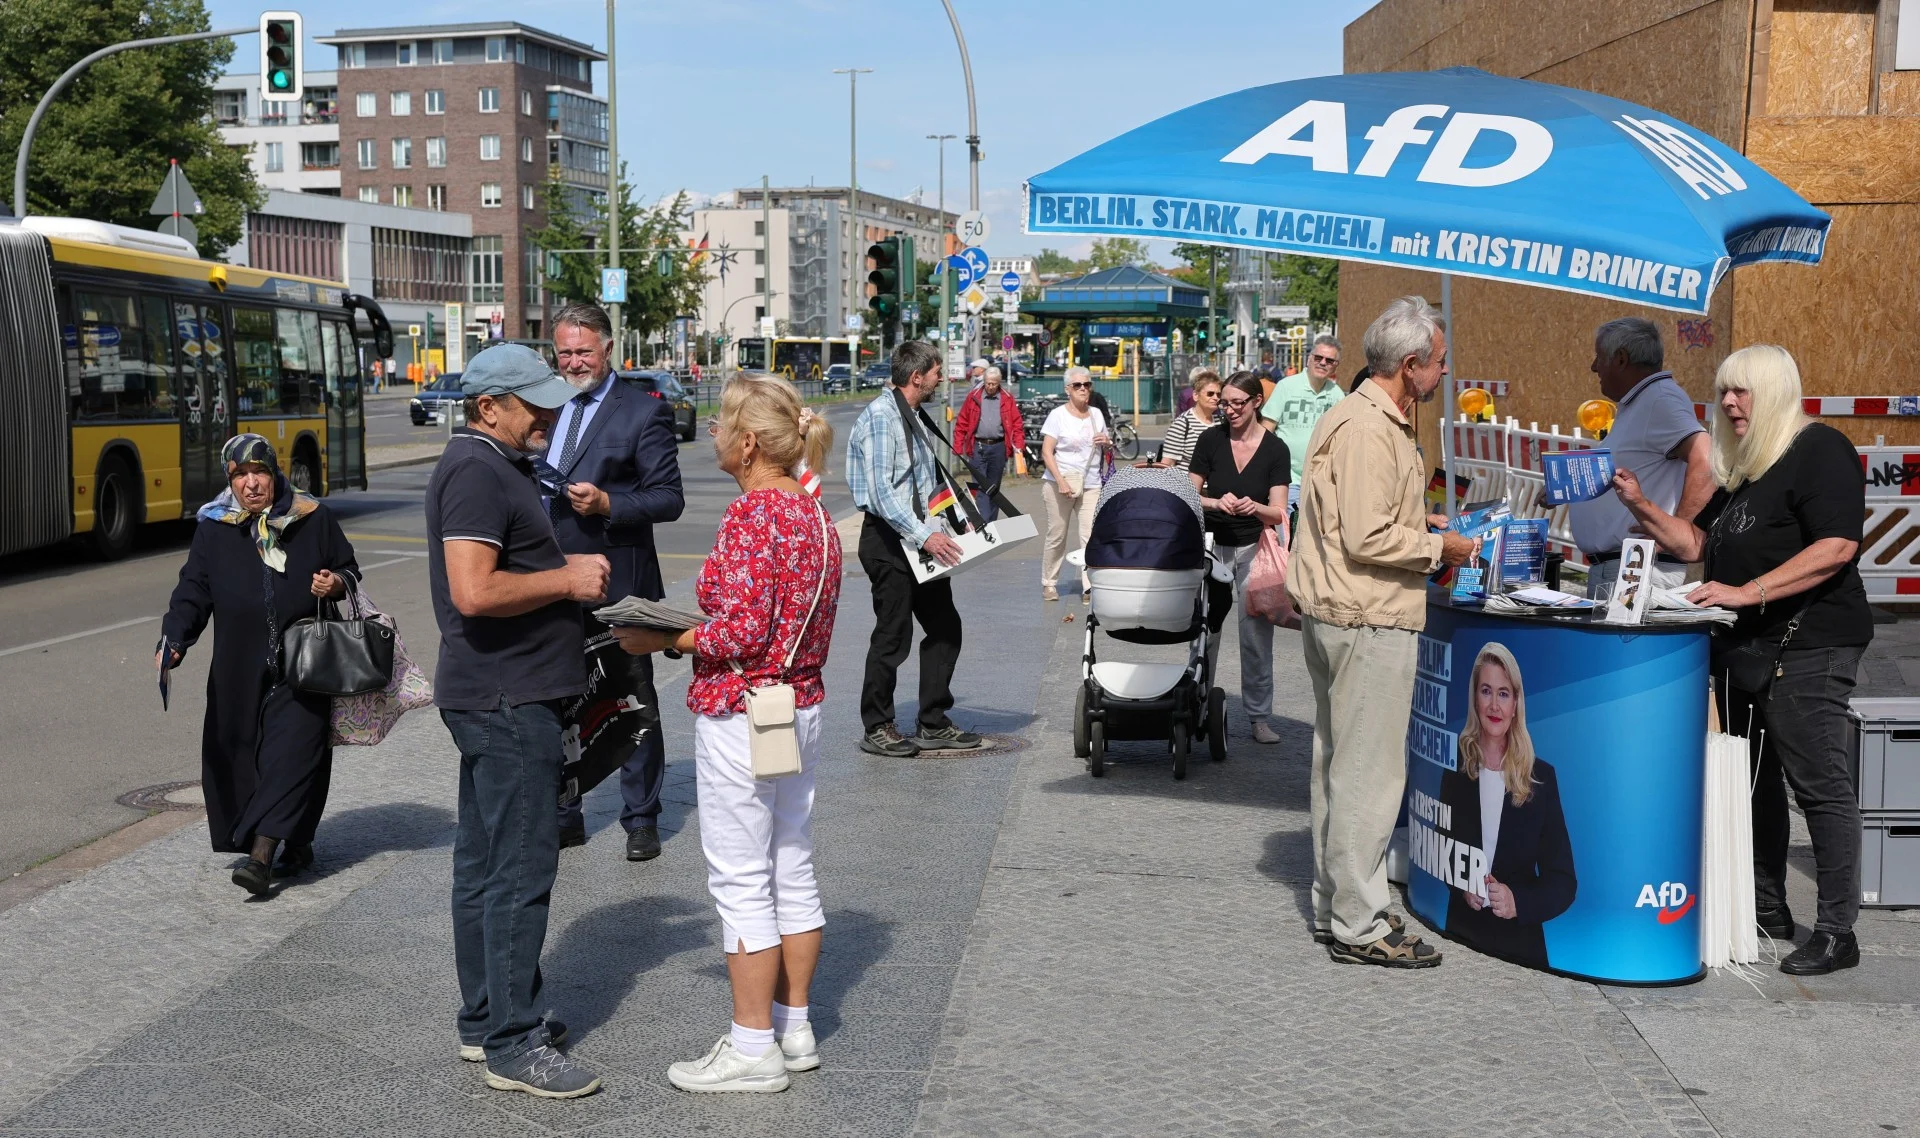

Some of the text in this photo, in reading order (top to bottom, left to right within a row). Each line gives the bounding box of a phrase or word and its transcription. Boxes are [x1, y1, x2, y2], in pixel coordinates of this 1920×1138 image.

[1219, 100, 1554, 188] AfD
[1611, 114, 1748, 201] AfD
[1039, 196, 1702, 301] BERLIN. STARK. MACHEN. mit KRISTIN BRINKER
[1415, 789, 1451, 831] KRISTIN
[1635, 881, 1687, 908] AfD
